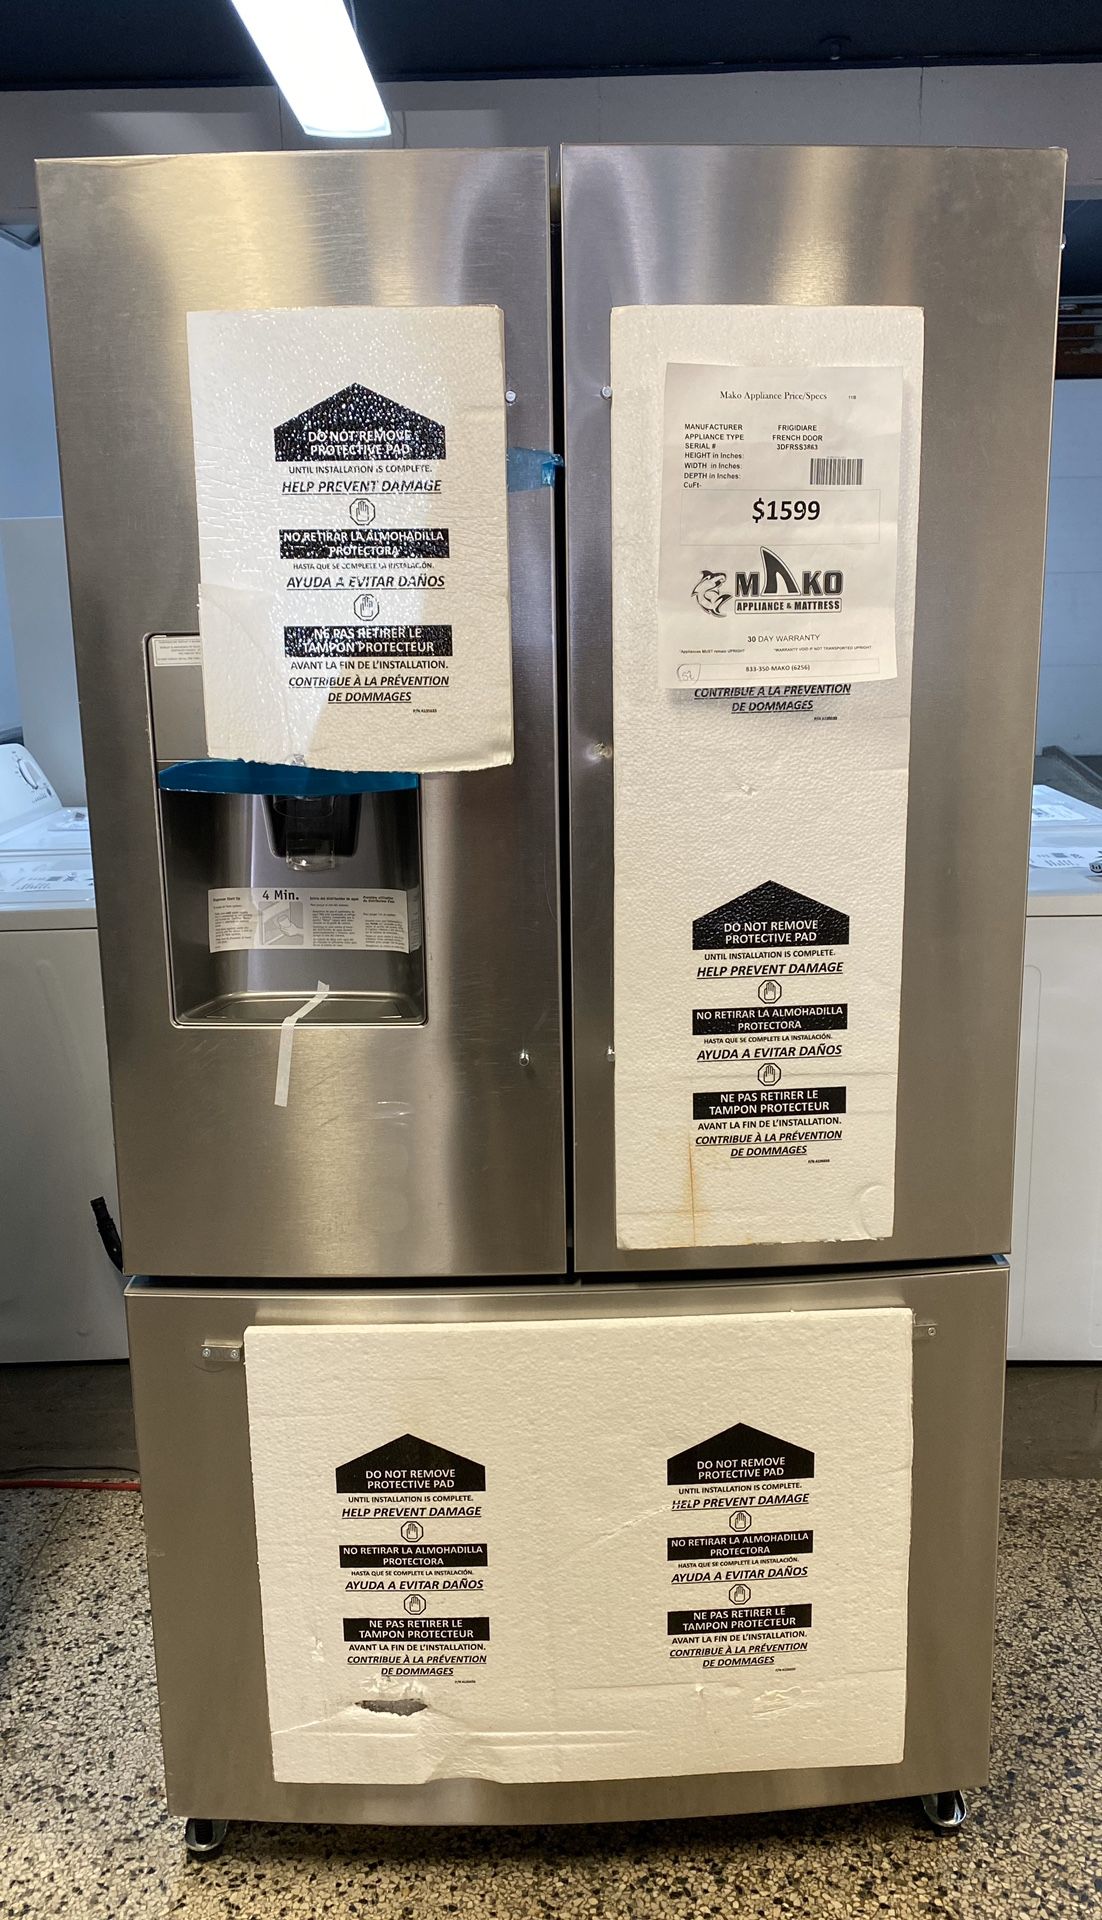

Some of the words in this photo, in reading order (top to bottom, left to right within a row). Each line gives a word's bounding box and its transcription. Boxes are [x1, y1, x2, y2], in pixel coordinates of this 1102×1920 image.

[720, 391, 742, 399] Mako
[744, 391, 781, 401] Appliance
[784, 392, 827, 401] Price/Specs
[309, 431, 326, 442] DO
[330, 431, 355, 442] NOT
[360, 430, 412, 441] REMOVE
[311, 444, 381, 455] PROTECTIVE
[386, 444, 409, 454] PAD
[282, 482, 314, 492] HELP
[319, 481, 377, 492] PREVENT
[382, 480, 442, 492] DAMAGE
[752, 498, 821, 523] $1599
[735, 546, 844, 597] MAKO
[737, 601, 784, 611] APPLIANCE
[787, 601, 792, 610] &
[794, 601, 839, 610] MATTRESS
[758, 635, 773, 643] DAY
[776, 634, 820, 642] WARRANTY
[303, 642, 354, 652] TAMPON
[359, 642, 433, 652] PROTECTEUR
[291, 661, 322, 670] AVANT
[326, 661, 336, 669] LA
[358, 661, 369, 669] DE
[289, 677, 350, 686] CONTRIBUE
[354, 675, 361, 686] À
[365, 676, 377, 686] LA
[381, 675, 449, 685] PRÉVENTION
[328, 693, 342, 702] DE
[345, 692, 411, 701] DOMMAGES
[695, 686, 755, 698] CONTRIBUE
[769, 686, 780, 696] LA
[732, 702, 746, 712] DE
[749, 700, 813, 712] DOMMAGES
[263, 890, 268, 900] 4
[274, 890, 299, 900] Min.
[724, 923, 740, 932] DO
[744, 922, 767, 931] NOT
[771, 920, 818, 931] REMOVE
[726, 933, 791, 944] PROTECTIVE
[795, 932, 816, 942] PAD
[697, 966, 727, 977] HELP
[731, 964, 785, 975] PREVENT
[789, 962, 843, 973] DAMAGE
[697, 1011, 711, 1020] NO
[715, 1010, 755, 1019] RETIRAR
[758, 1009, 769, 1018] LA
[772, 1007, 843, 1017] ALMOHADILLA
[738, 1021, 801, 1031] PROTECTORA
[697, 1049, 738, 1060] AYUDA
[742, 1049, 750, 1058] A
[755, 1047, 796, 1058] EVITAR
[800, 1043, 842, 1056] DAÑOS
[720, 1094, 734, 1103] NE
[738, 1093, 757, 1102] PAS
[761, 1091, 804, 1101] RETIRER
[807, 1090, 818, 1099] LE
[709, 1105, 757, 1115] TAMPON
[761, 1102, 829, 1113] PROTECTEUR
[698, 1122, 727, 1130] AVANT
[730, 1121, 740, 1129] LA
[759, 1120, 770, 1128] DE
[696, 1135, 752, 1144] CONTRIBUE
[755, 1132, 762, 1142] À
[765, 1134, 776, 1142] LA
[780, 1130, 842, 1141] PRÉVENTION
[731, 1149, 743, 1157] DE
[747, 1146, 807, 1156] DOMMAGES
[366, 1471, 381, 1479] DO
[385, 1470, 407, 1478] NOT
[410, 1469, 455, 1478] REMOVE
[368, 1480, 430, 1489] PROTECTIVE
[434, 1480, 454, 1488] PAD
[702, 1485, 751, 1493] INSTALLATION
[672, 1499, 700, 1509] HELP
[703, 1496, 755, 1507] PREVENT
[758, 1494, 809, 1505] DAMAGE
[342, 1508, 370, 1517] HELP
[374, 1507, 426, 1516] PREVENT
[429, 1507, 481, 1516] DAMAGE
[672, 1539, 685, 1547] NO
[689, 1537, 726, 1546] RETIRAR
[729, 1536, 740, 1544] LA
[743, 1533, 808, 1543] ALMOHADILLA
[710, 1546, 770, 1556] PROTECTORA
[345, 1581, 384, 1589] AYUDA
[388, 1581, 396, 1589] A
[400, 1580, 439, 1589] EVITAR
[443, 1578, 483, 1589] DAÑOS
[694, 1612, 707, 1620] NE
[710, 1611, 728, 1619] PAS
[732, 1609, 772, 1618] RETIRER
[775, 1608, 785, 1616] LE
[683, 1621, 728, 1631] TAMPON
[731, 1617, 796, 1628] PROTECTEUR
[347, 1656, 400, 1664] CONTRIBUE
[404, 1653, 410, 1663] À
[427, 1653, 486, 1663] PRÉVENTION
[396, 1667, 453, 1675] DOMMAGES
